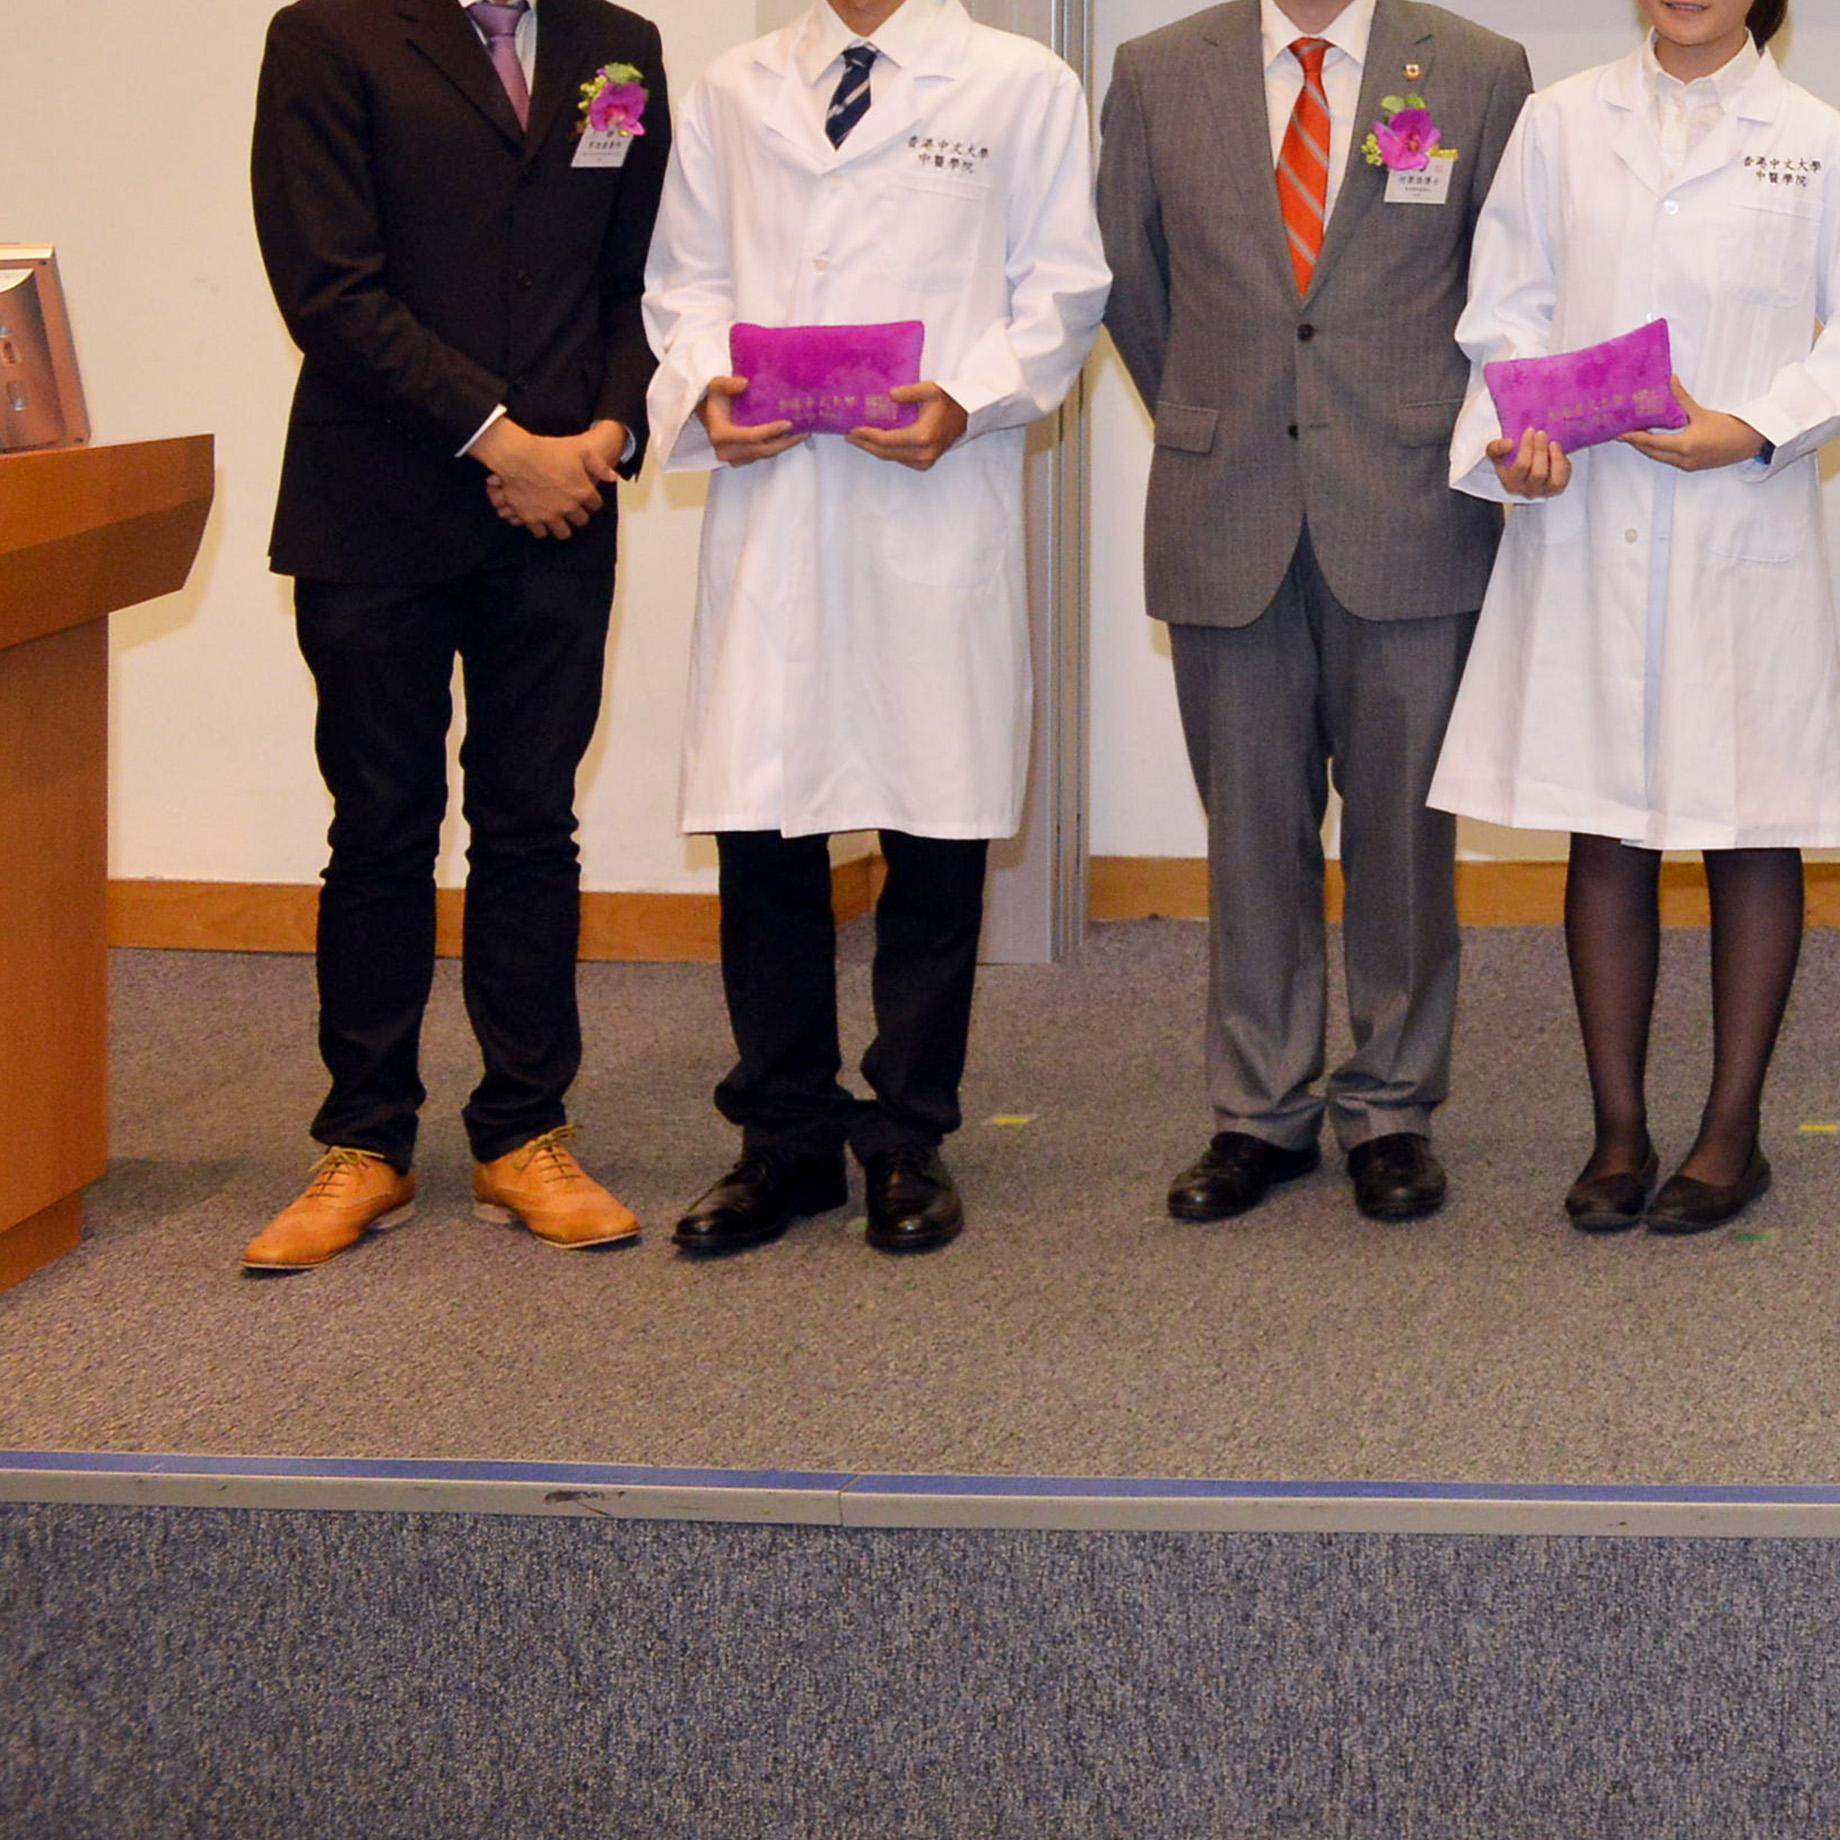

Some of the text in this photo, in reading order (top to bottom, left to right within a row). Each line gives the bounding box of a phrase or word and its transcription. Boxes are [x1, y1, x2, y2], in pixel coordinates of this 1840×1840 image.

[908, 135, 989, 159] 香港中文大學
[1744, 155, 1822, 174] 香港中文大學
[1755, 170, 1807, 188] 中醫學院
